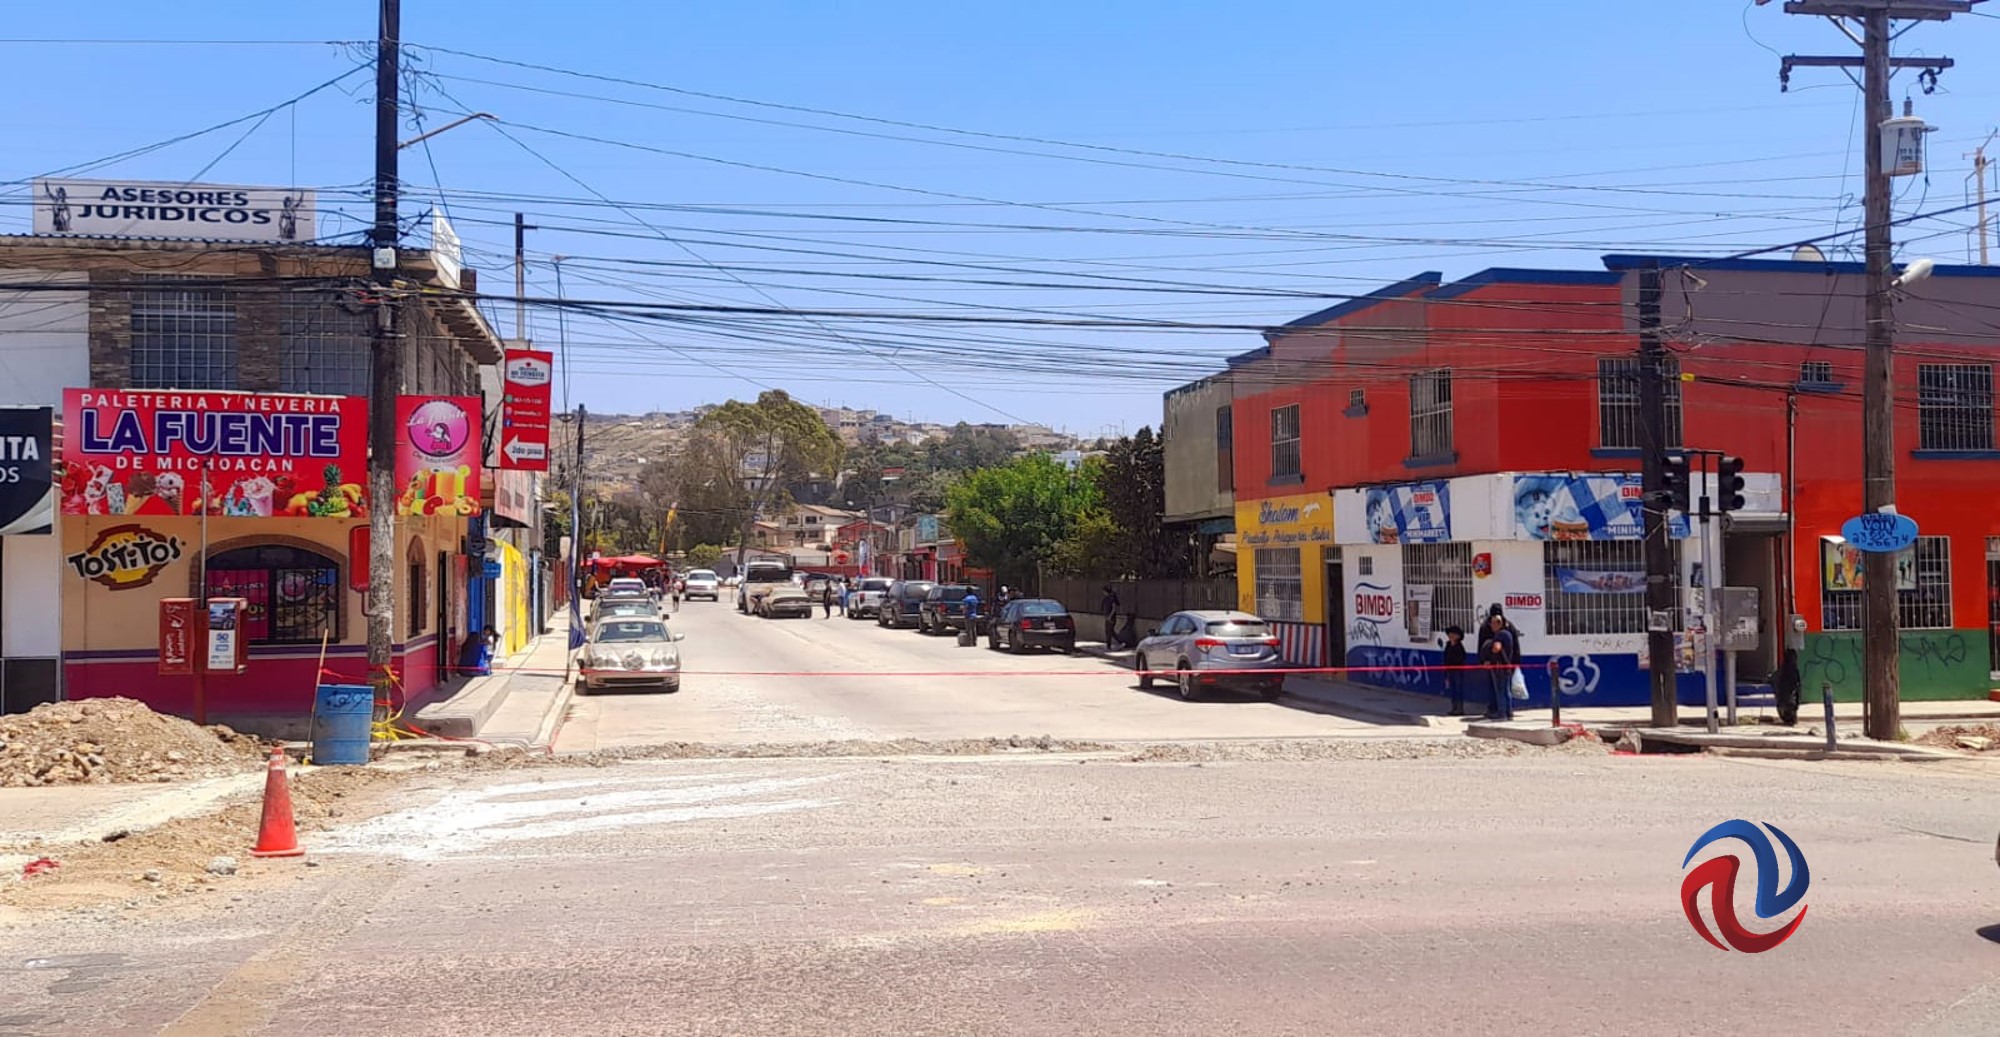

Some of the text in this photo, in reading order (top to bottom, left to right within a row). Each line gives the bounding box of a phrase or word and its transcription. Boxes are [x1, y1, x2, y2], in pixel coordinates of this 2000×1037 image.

[100, 187, 249, 207] ASESORES
[77, 204, 272, 224] JURIDICOS
[80, 393, 208, 410] PALETERIA
[221, 399, 232, 408] Y
[82, 408, 342, 458] LA FUENTE
[115, 456, 294, 472] DE MICHOACAN
[1355, 594, 1394, 617] BIMBO
[1505, 595, 1542, 607] BIMBO
